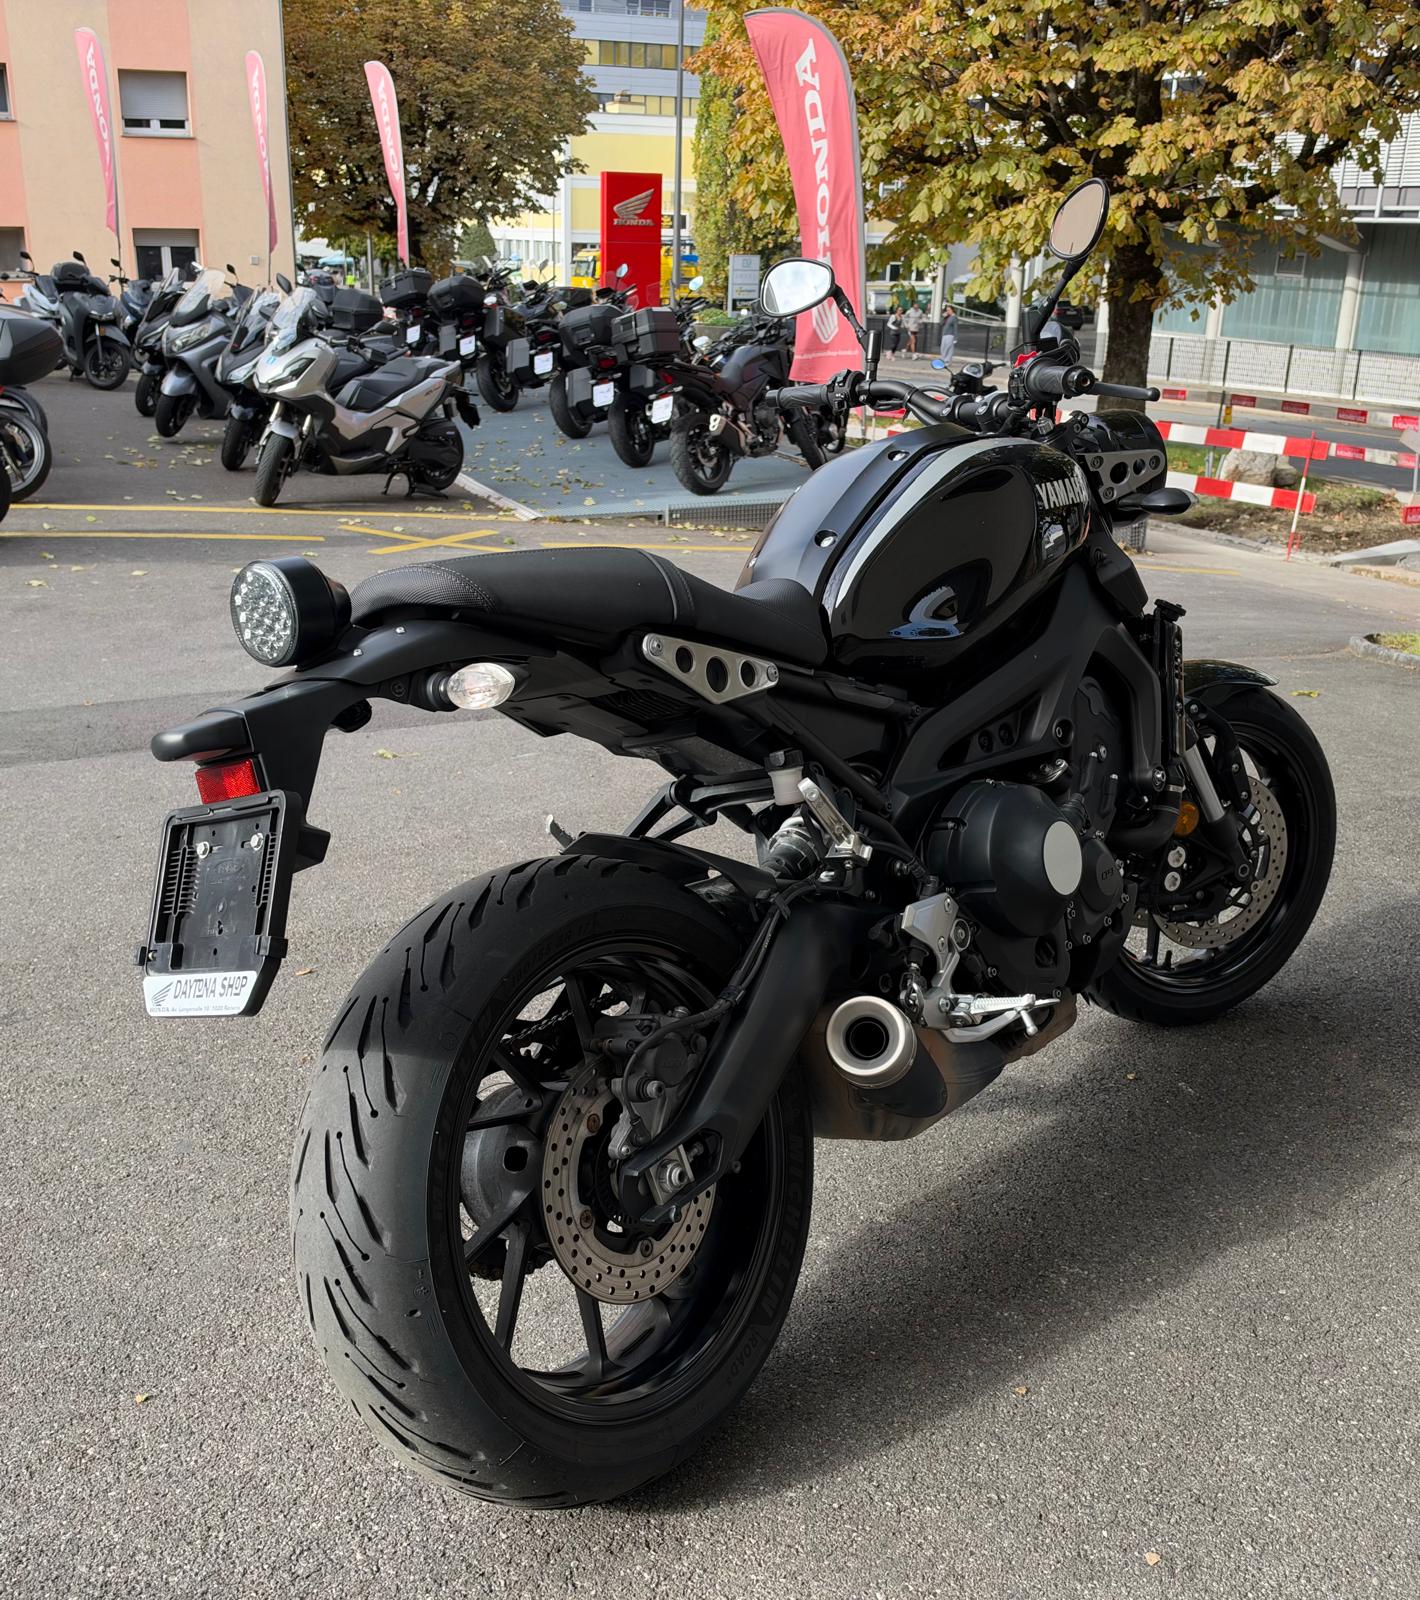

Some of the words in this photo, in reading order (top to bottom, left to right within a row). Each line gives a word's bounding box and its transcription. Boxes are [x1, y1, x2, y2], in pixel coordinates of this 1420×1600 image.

[794, 37, 833, 266] HONDA
[613, 218, 655, 227] HONDA
[173, 978, 217, 999] DAYTONA
[219, 975, 248, 997] SHOP
